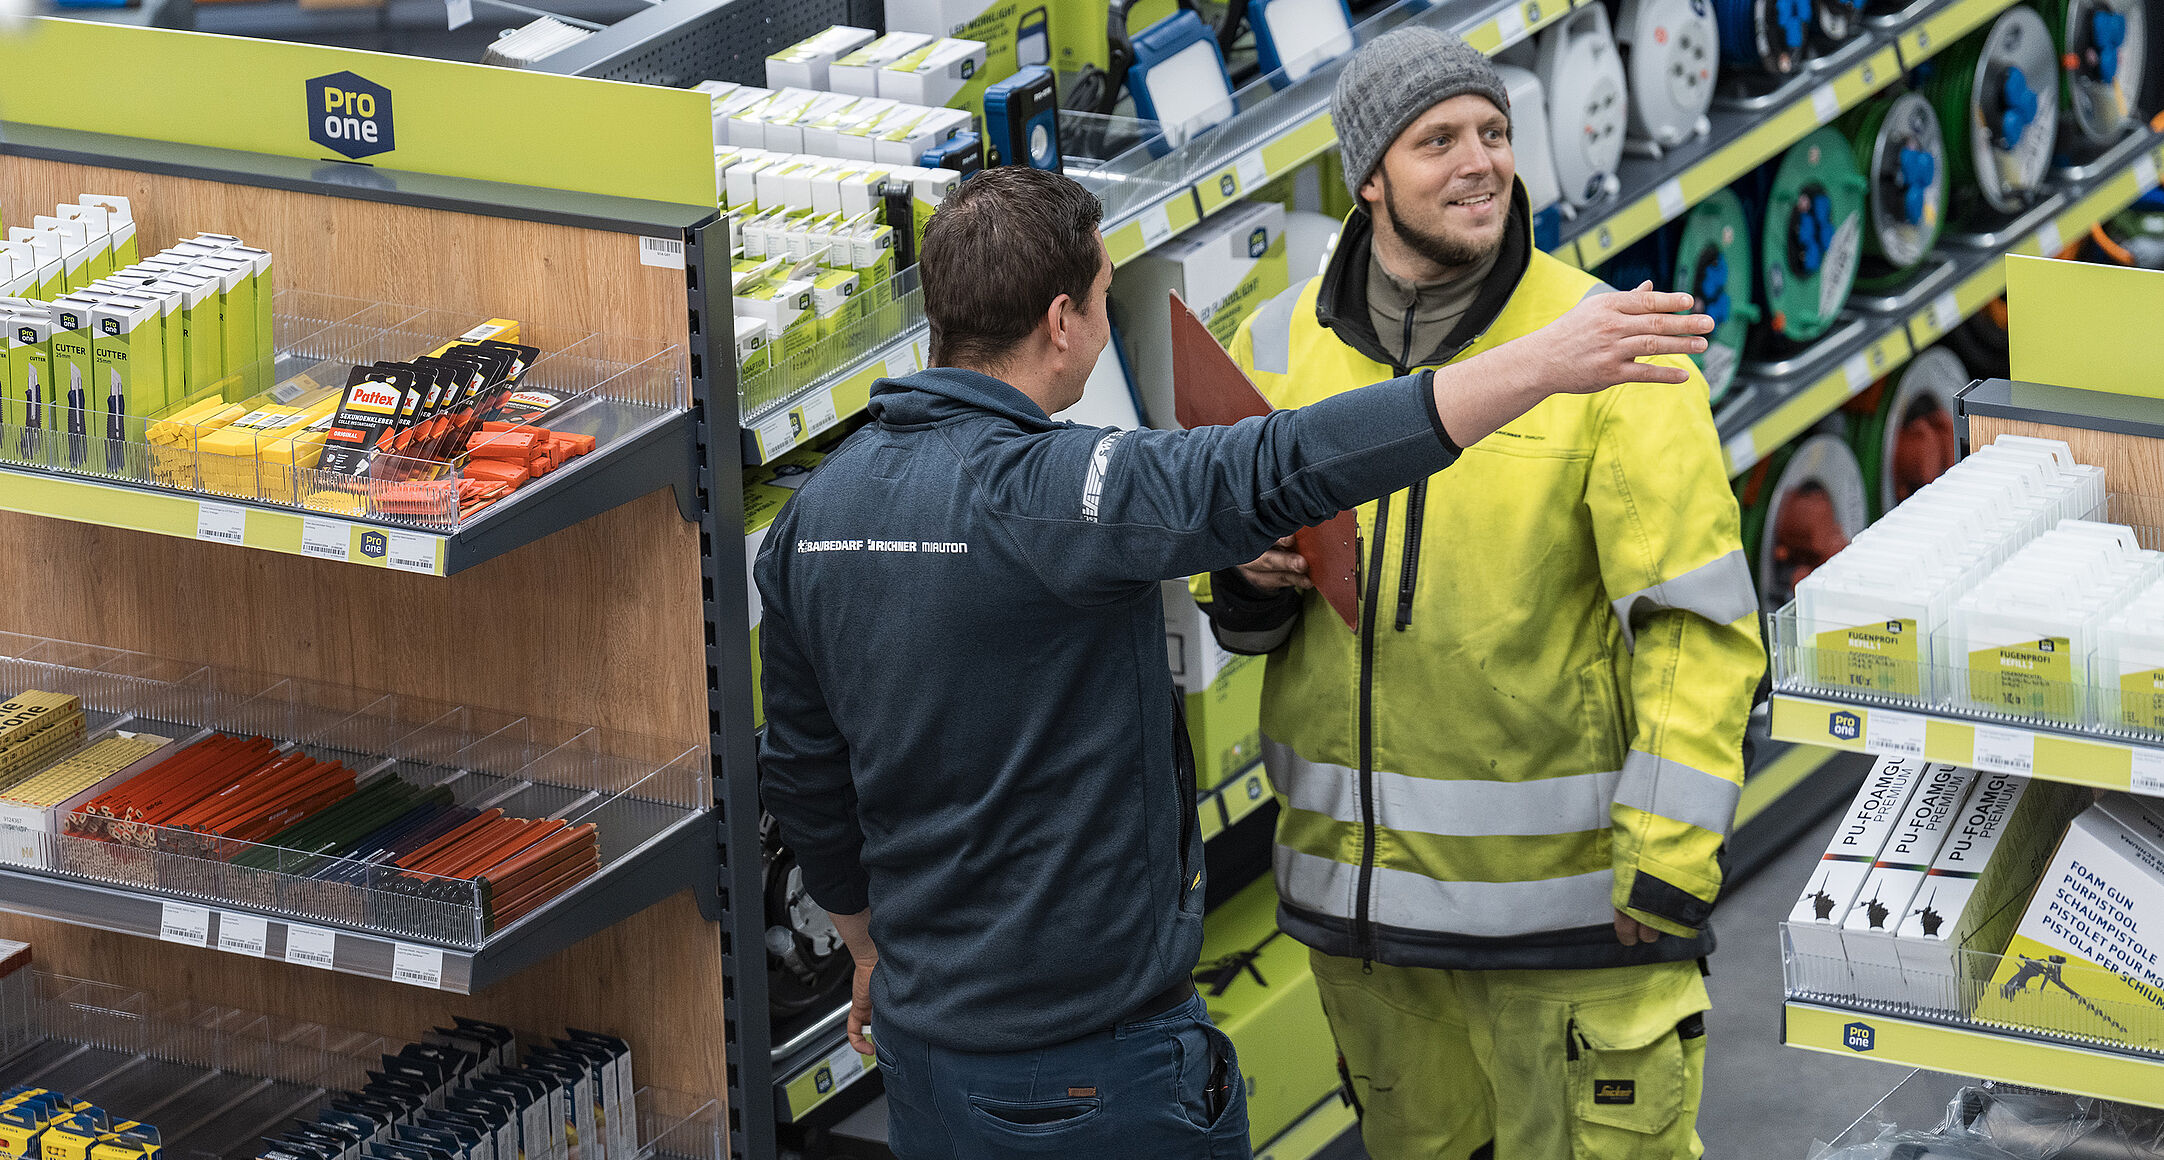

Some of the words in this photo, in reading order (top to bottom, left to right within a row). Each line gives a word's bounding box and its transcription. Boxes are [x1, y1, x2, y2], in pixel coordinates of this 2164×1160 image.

[325, 115, 378, 143] one
[55, 343, 86, 356] CUTTER
[96, 348, 127, 361] CUTTER
[353, 388, 395, 406] Pattex
[512, 393, 552, 404] Pattex
[339, 412, 394, 426] SEKUNDENKLEBER
[333, 430, 358, 439] ORIGINAL
[364, 544, 382, 554] one
[807, 539, 864, 552] BAUBEDARF
[875, 540, 917, 552] RICHNER
[1848, 631, 1899, 645] FUGENPROFI
[1848, 639, 1876, 650] REFILL
[2000, 650, 2051, 664] FUGENPROFI
[2000, 658, 2028, 669] REFILL
[1834, 723, 1855, 737] one
[1843, 757, 1905, 846] PU-FOAMGU
[1874, 768, 1914, 823] PREMIUM
[1895, 766, 1957, 854] PU-FOAMGU
[1926, 776, 1965, 832] PREMIUM
[1979, 783, 2019, 839] PREMIUM
[1949, 774, 2010, 862] PU-FOAMGU
[2070, 860, 2107, 891] FOAM
[2107, 887, 2134, 911] GUN
[2063, 874, 2138, 934] PURPISTOOL
[2055, 887, 2158, 966] SCHAUMPISTOLE
[2049, 901, 2109, 947] PISTOLET
[2108, 943, 2143, 974] POUR
[2143, 968, 2164, 992] MO
[2042, 915, 2094, 958] PISTOLA
[2094, 953, 2120, 974] PER
[2119, 971, 2164, 1011] SCHIUM
[1848, 1036, 1869, 1048] one
